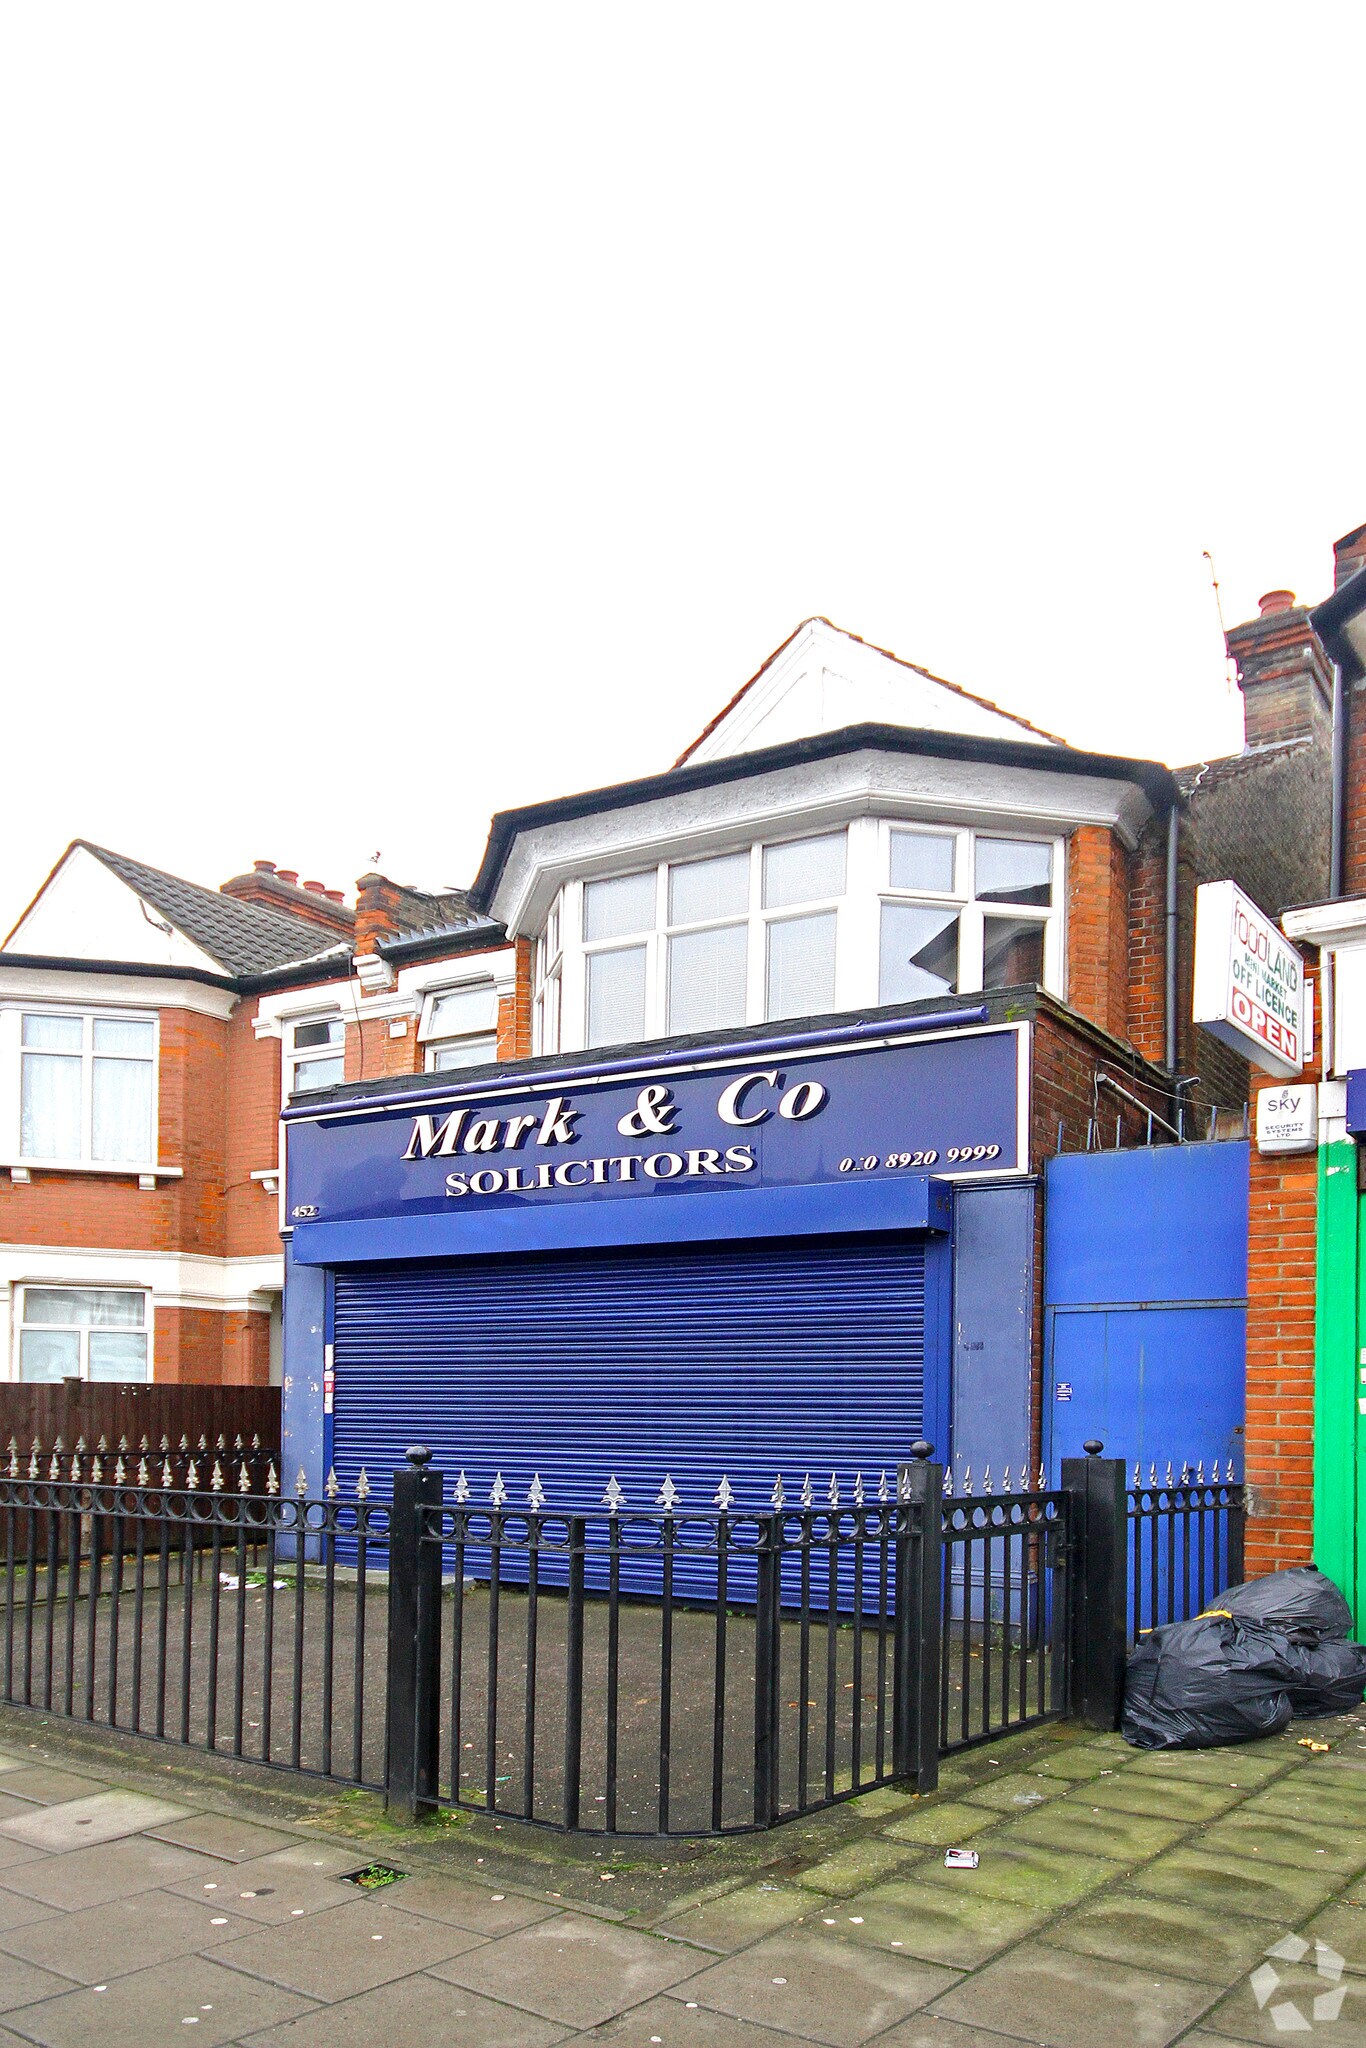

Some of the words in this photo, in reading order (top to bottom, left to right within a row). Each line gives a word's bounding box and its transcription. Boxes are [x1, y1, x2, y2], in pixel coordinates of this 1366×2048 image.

[1232, 958, 1252, 989] OFF
[1255, 979, 1298, 1030] LICENCE
[1261, 968, 1288, 1001] MARKET
[1232, 991, 1296, 1060] OPEN
[400, 1096, 579, 1160] Mark
[616, 1084, 676, 1137] &
[717, 1070, 827, 1126] Co
[1265, 1122, 1304, 1131] SECURITY
[1266, 1127, 1304, 1135] SYSTEMS
[445, 1144, 756, 1198] SOLICITORS
[885, 1149, 938, 1169] 8920
[947, 1144, 1000, 1164] 9999
[291, 1204, 316, 1218] 452
